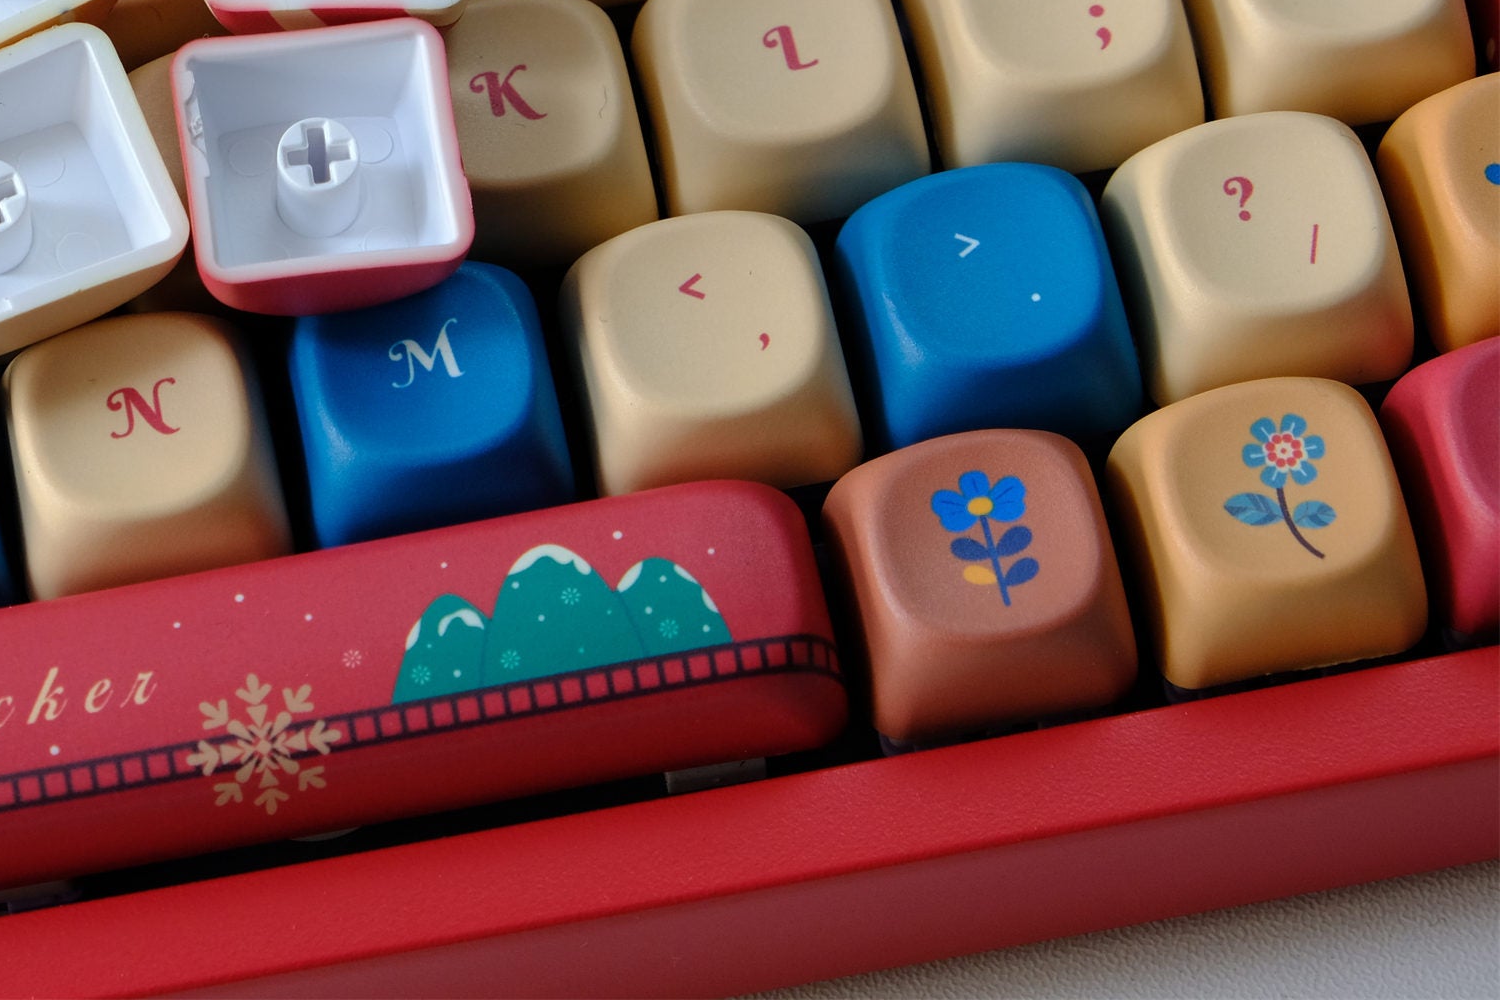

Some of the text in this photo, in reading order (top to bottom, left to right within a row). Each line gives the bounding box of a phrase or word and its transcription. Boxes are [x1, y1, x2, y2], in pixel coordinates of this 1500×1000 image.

[762, 25, 819, 71] L
[470, 65, 547, 120] K
[1223, 176, 1254, 221] ?
[389, 318, 464, 388] M
[107, 377, 180, 439] N
